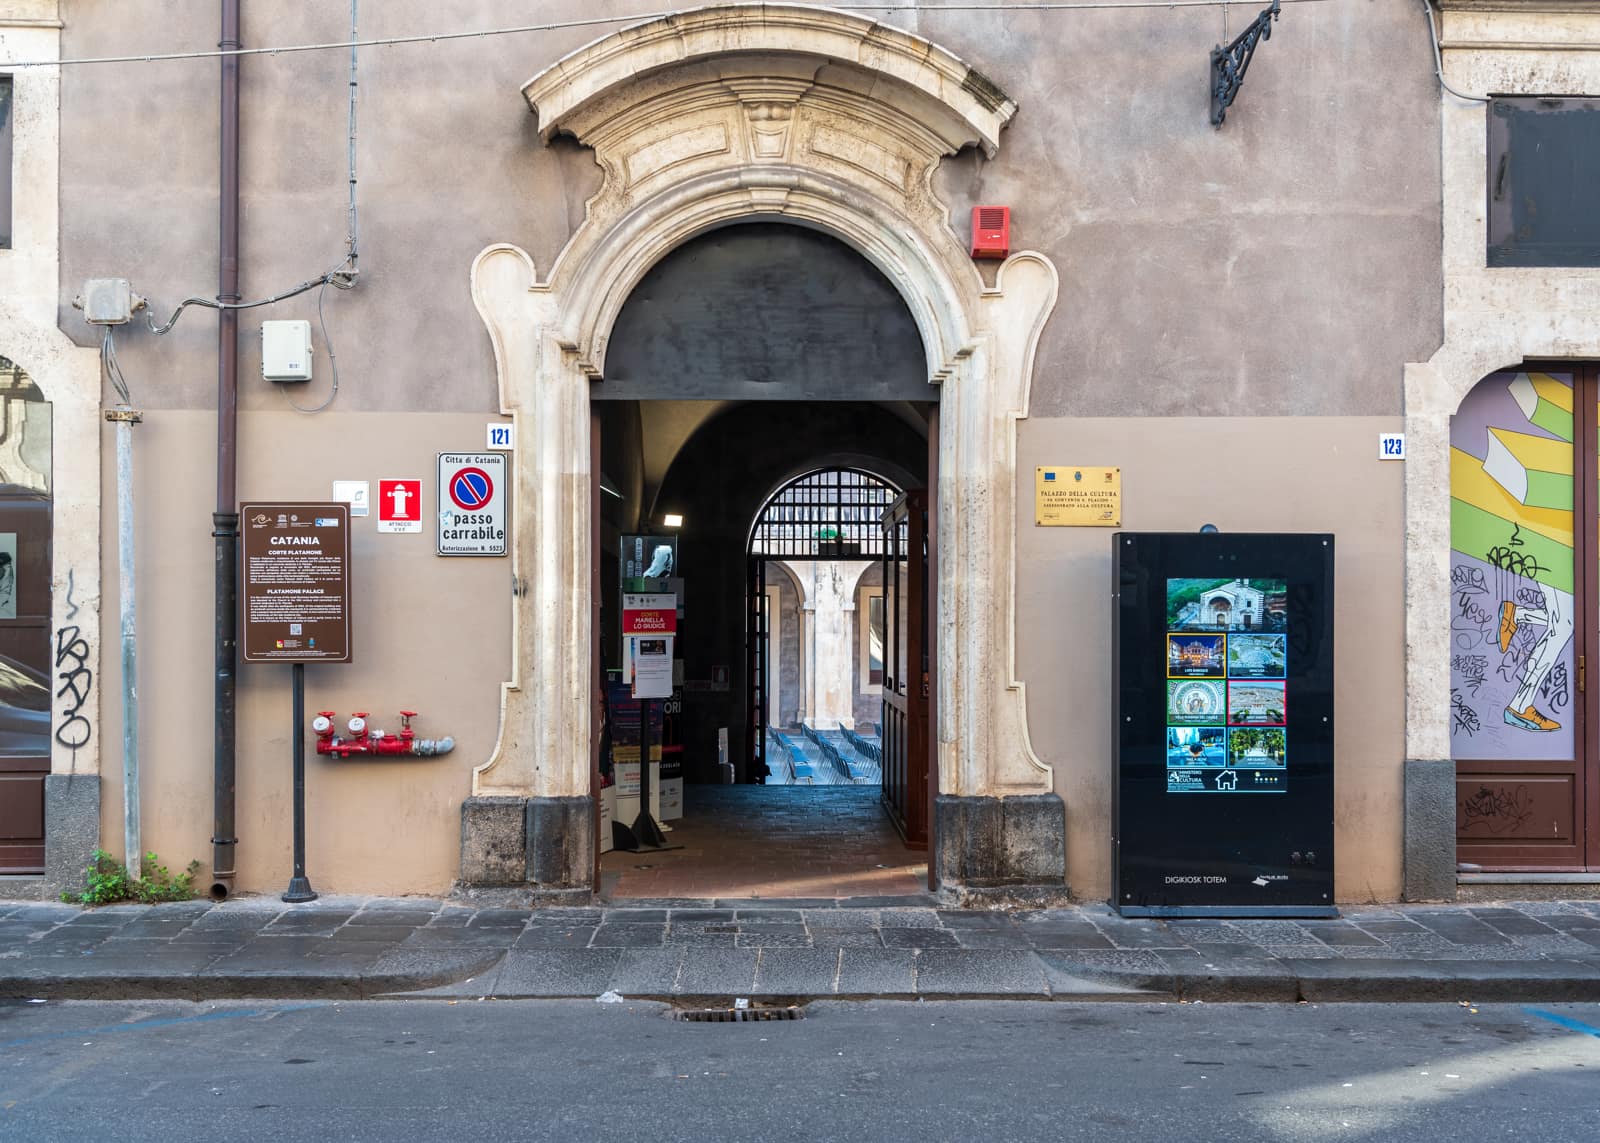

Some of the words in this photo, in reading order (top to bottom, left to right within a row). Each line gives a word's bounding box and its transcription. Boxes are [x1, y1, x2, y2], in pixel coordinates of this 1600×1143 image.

[491, 428, 509, 445] 121
[1383, 438, 1402, 455] 123
[465, 456, 472, 464] di
[474, 456, 501, 464] Catania
[454, 514, 493, 527] passo
[443, 526, 504, 540] carrabile
[270, 536, 320, 545] CATANIA
[1165, 876, 1202, 884] DIGIKIOSK
[1203, 876, 1227, 884] TOTEM
